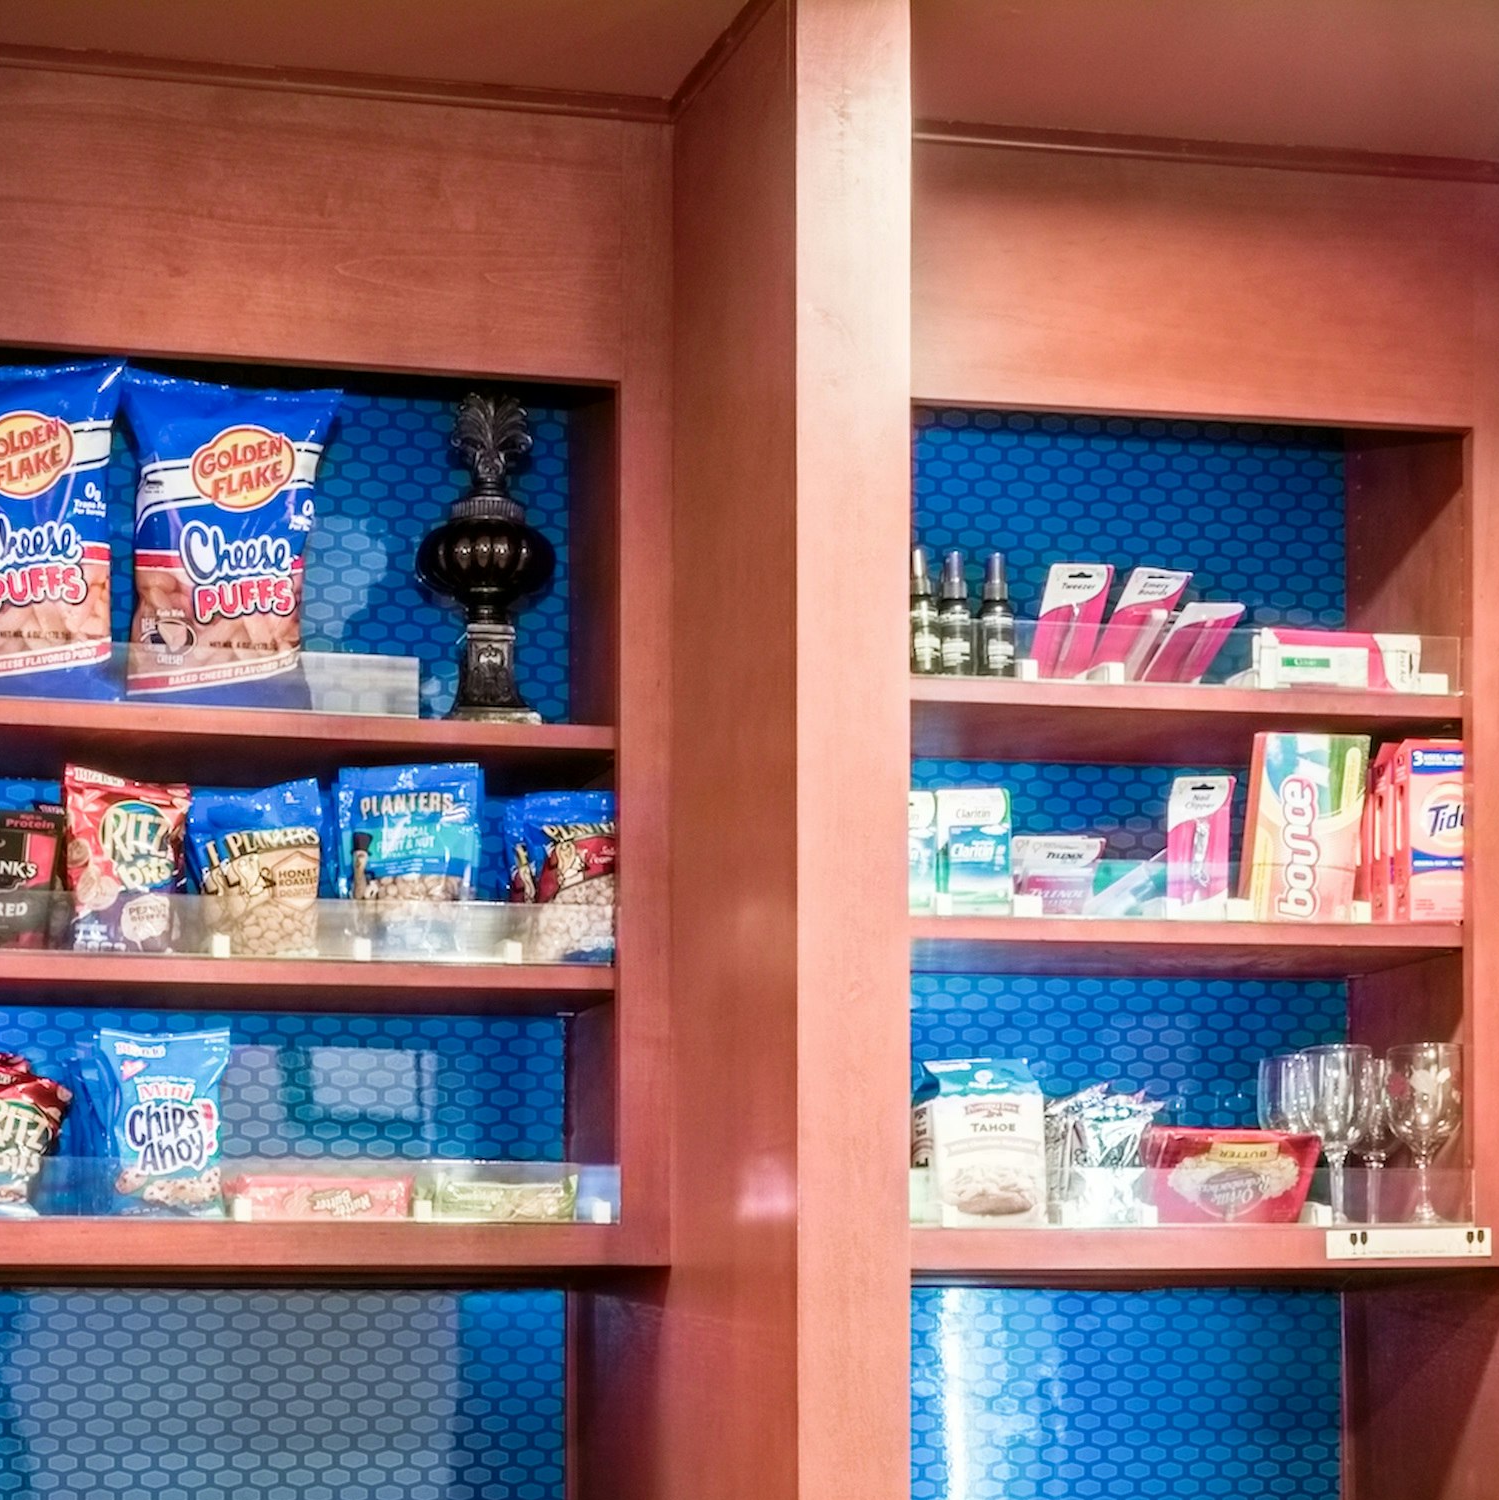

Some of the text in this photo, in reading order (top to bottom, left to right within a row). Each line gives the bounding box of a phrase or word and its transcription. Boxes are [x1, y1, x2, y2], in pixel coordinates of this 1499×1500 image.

[197, 435, 285, 478] GOLDEN
[210, 460, 285, 500] FLAKE
[181, 522, 293, 581] Cheese
[196, 575, 296, 621] PUFFS
[1061, 581, 1097, 592] Tweezer
[359, 791, 455, 821] PLANTERS
[955, 808, 992, 820] Claritin
[1428, 804, 1464, 838] Tid
[5, 817, 56, 831] Protein
[102, 807, 172, 862] RITZ
[1278, 777, 1320, 920] bounce
[139, 1084, 193, 1102] Mini
[128, 1104, 201, 1148] Chips
[969, 1122, 1017, 1134] TAHOE
[1218, 1149, 1269, 1160] BUTTER
[311, 1188, 352, 1212] Butter
[331, 1195, 374, 1217] Nutter
